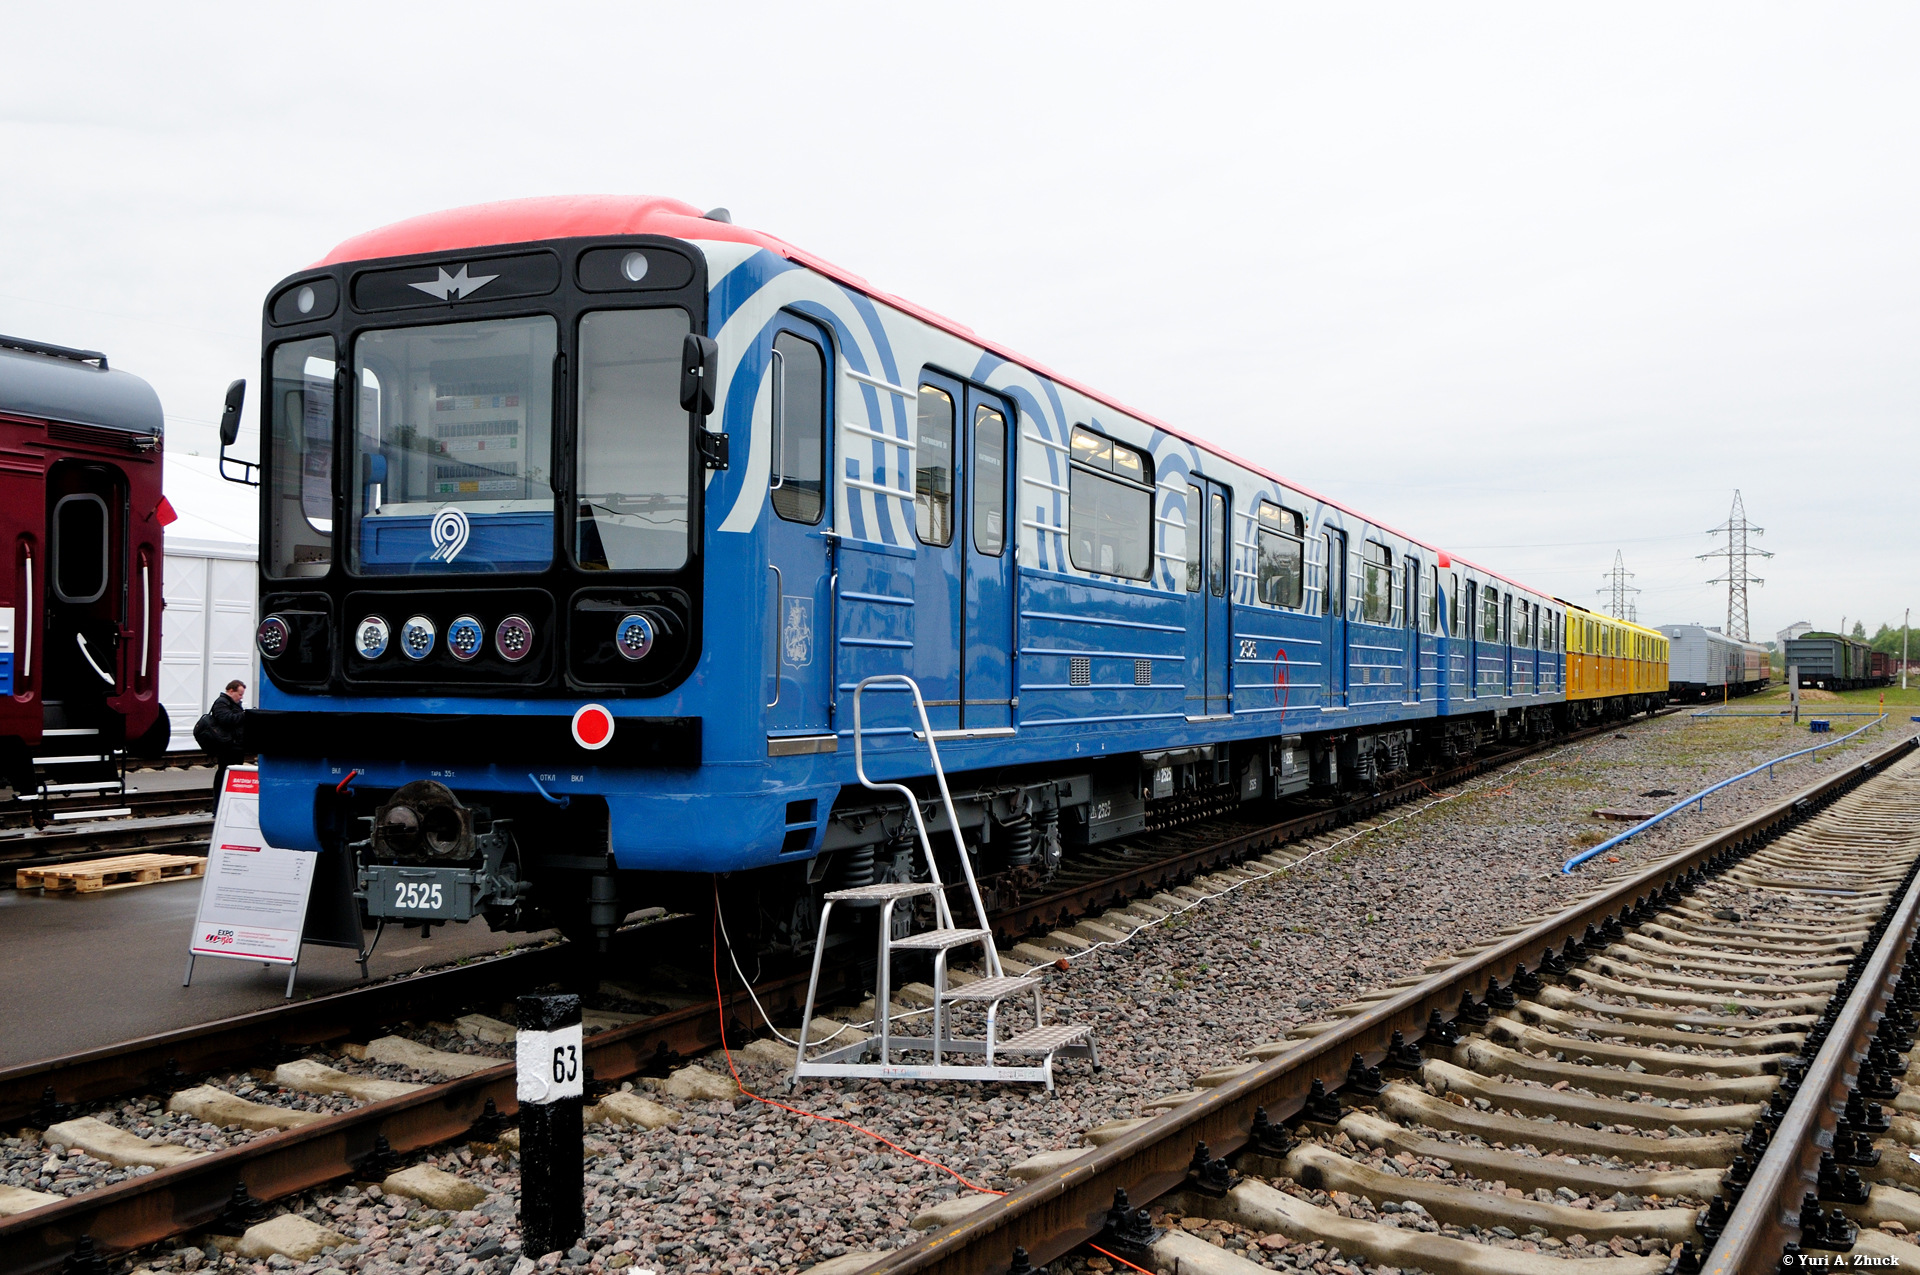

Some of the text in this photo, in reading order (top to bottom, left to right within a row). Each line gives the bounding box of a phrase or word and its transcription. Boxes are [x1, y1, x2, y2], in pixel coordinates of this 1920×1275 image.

[331, 767, 341, 775] ВКЛ
[395, 882, 443, 909] 2525
[218, 929, 234, 937] EXPO
[553, 1045, 577, 1083] 63
